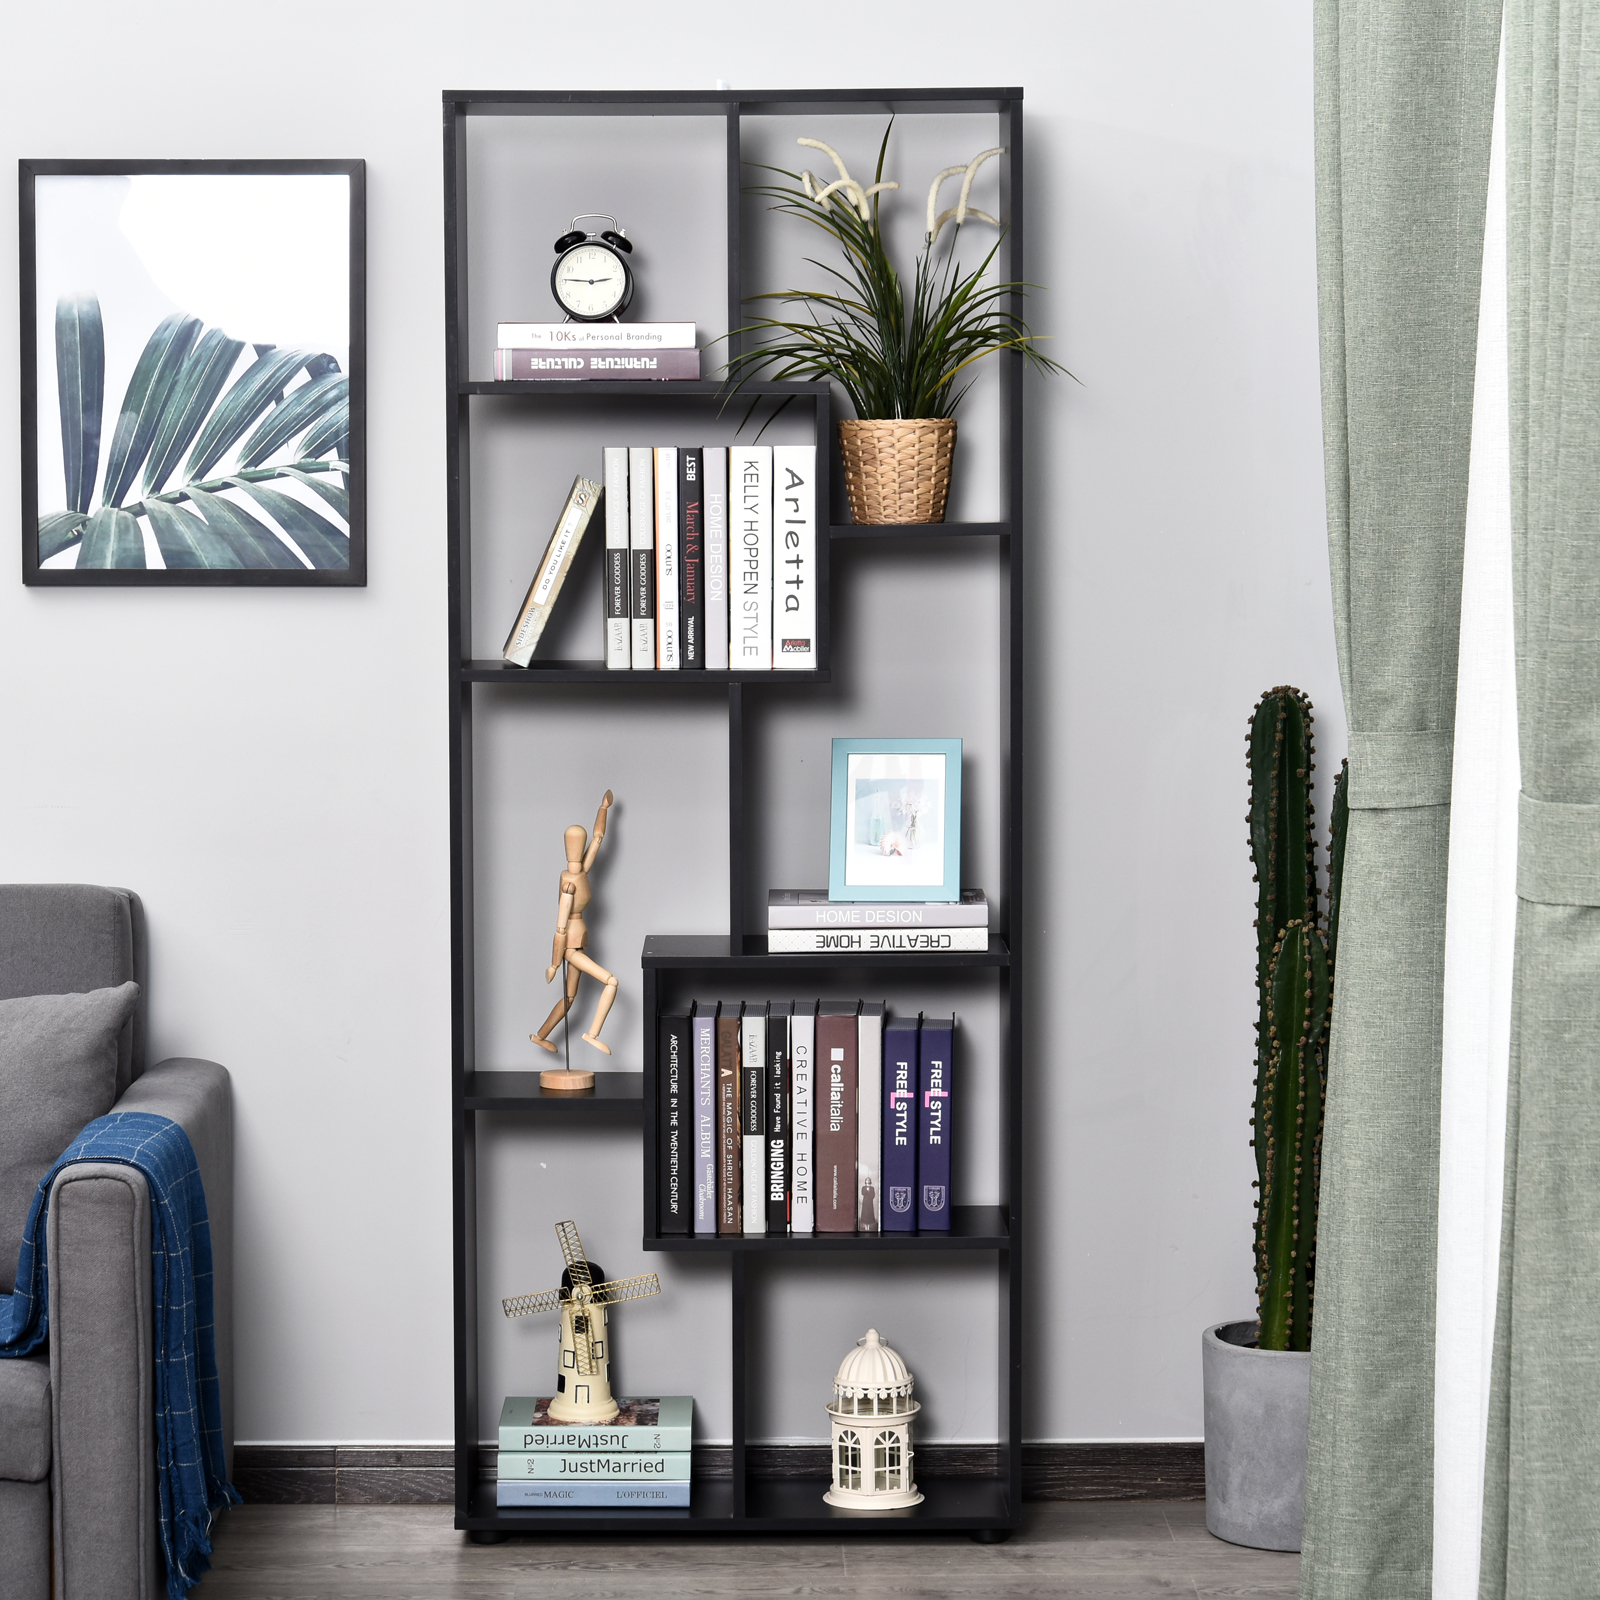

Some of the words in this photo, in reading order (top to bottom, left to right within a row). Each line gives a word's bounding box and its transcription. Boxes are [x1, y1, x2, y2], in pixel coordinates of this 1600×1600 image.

[549, 331, 576, 342] 10Ks
[627, 333, 662, 342] Branding
[531, 358, 584, 369] CULTURE
[591, 358, 657, 369] FURNITURE
[687, 455, 696, 481] BEST
[744, 461, 759, 514] KELLY
[613, 489, 620, 499] OF
[639, 490, 645, 500] OF
[686, 501, 699, 540] March
[710, 493, 722, 538] HOME
[542, 578, 550, 590] DO
[547, 559, 558, 576] YOU
[556, 539, 566, 558] LIKE
[564, 528, 570, 538] IT
[687, 544, 699, 553] &
[744, 521, 759, 594] HOPPEN
[785, 467, 806, 613] Arletta
[684, 556, 699, 604] January
[710, 543, 722, 600] DESION
[515, 606, 536, 646] SIDESHOW
[743, 600, 758, 656] STYLE
[816, 911, 860, 923] HOME
[865, 911, 922, 923] DESION
[816, 935, 861, 948] HOME
[870, 935, 951, 948] CREATIVE
[700, 1028, 710, 1105] MERCHANTS
[774, 1051, 782, 1078] lacking
[670, 1098, 678, 1108] IN
[796, 1045, 807, 1141] CREATIVE
[830, 1064, 844, 1132] caliaitalia
[700, 1115, 710, 1158] ALBUM
[896, 1102, 906, 1146] STYLE
[930, 1101, 941, 1145] STYLE
[726, 1138, 733, 1150] OF
[706, 1164, 714, 1199] Gästebäder
[750, 1184, 757, 1194] OF
[770, 1139, 784, 1201] BRINGING
[796, 1153, 807, 1205] HOME
[524, 1434, 629, 1448] JustMarried
[560, 1459, 665, 1473] JustMarried
